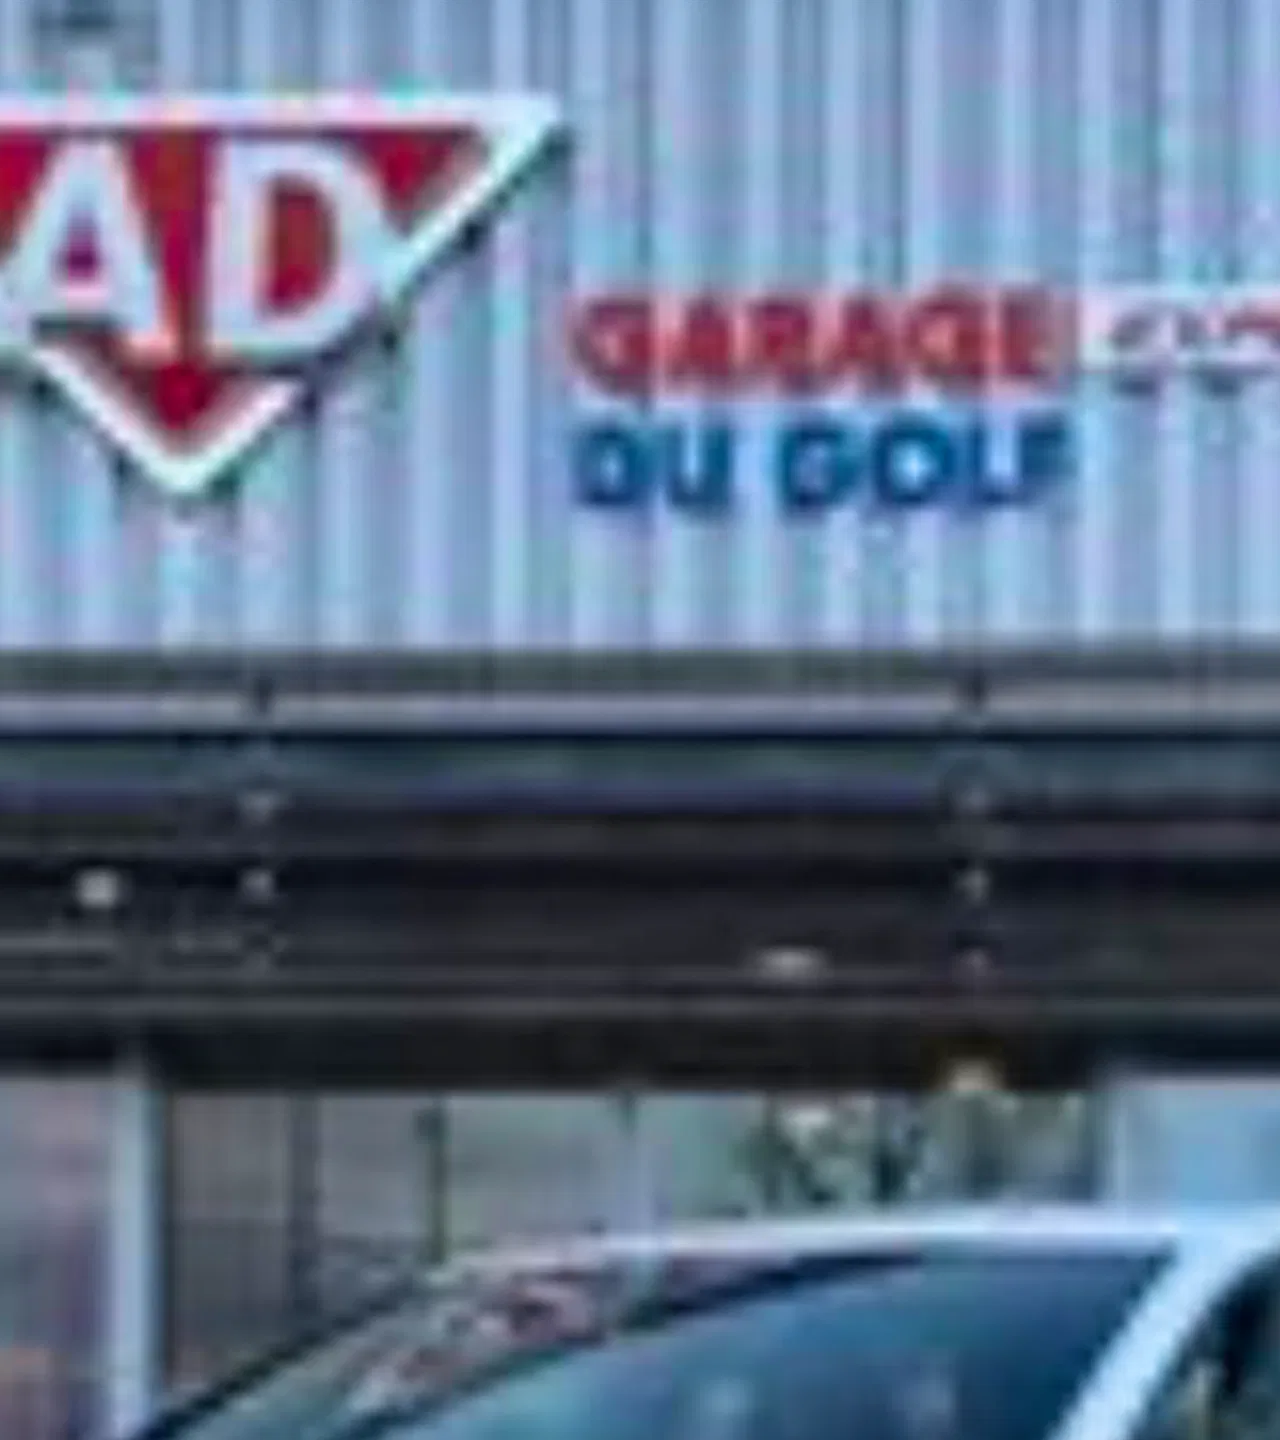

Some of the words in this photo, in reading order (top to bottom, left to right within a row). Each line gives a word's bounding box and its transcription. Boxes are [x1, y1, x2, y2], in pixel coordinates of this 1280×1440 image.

[572, 290, 1066, 398] GARAGE
[572, 414, 734, 514] DU
[776, 412, 1070, 514] GOLF
